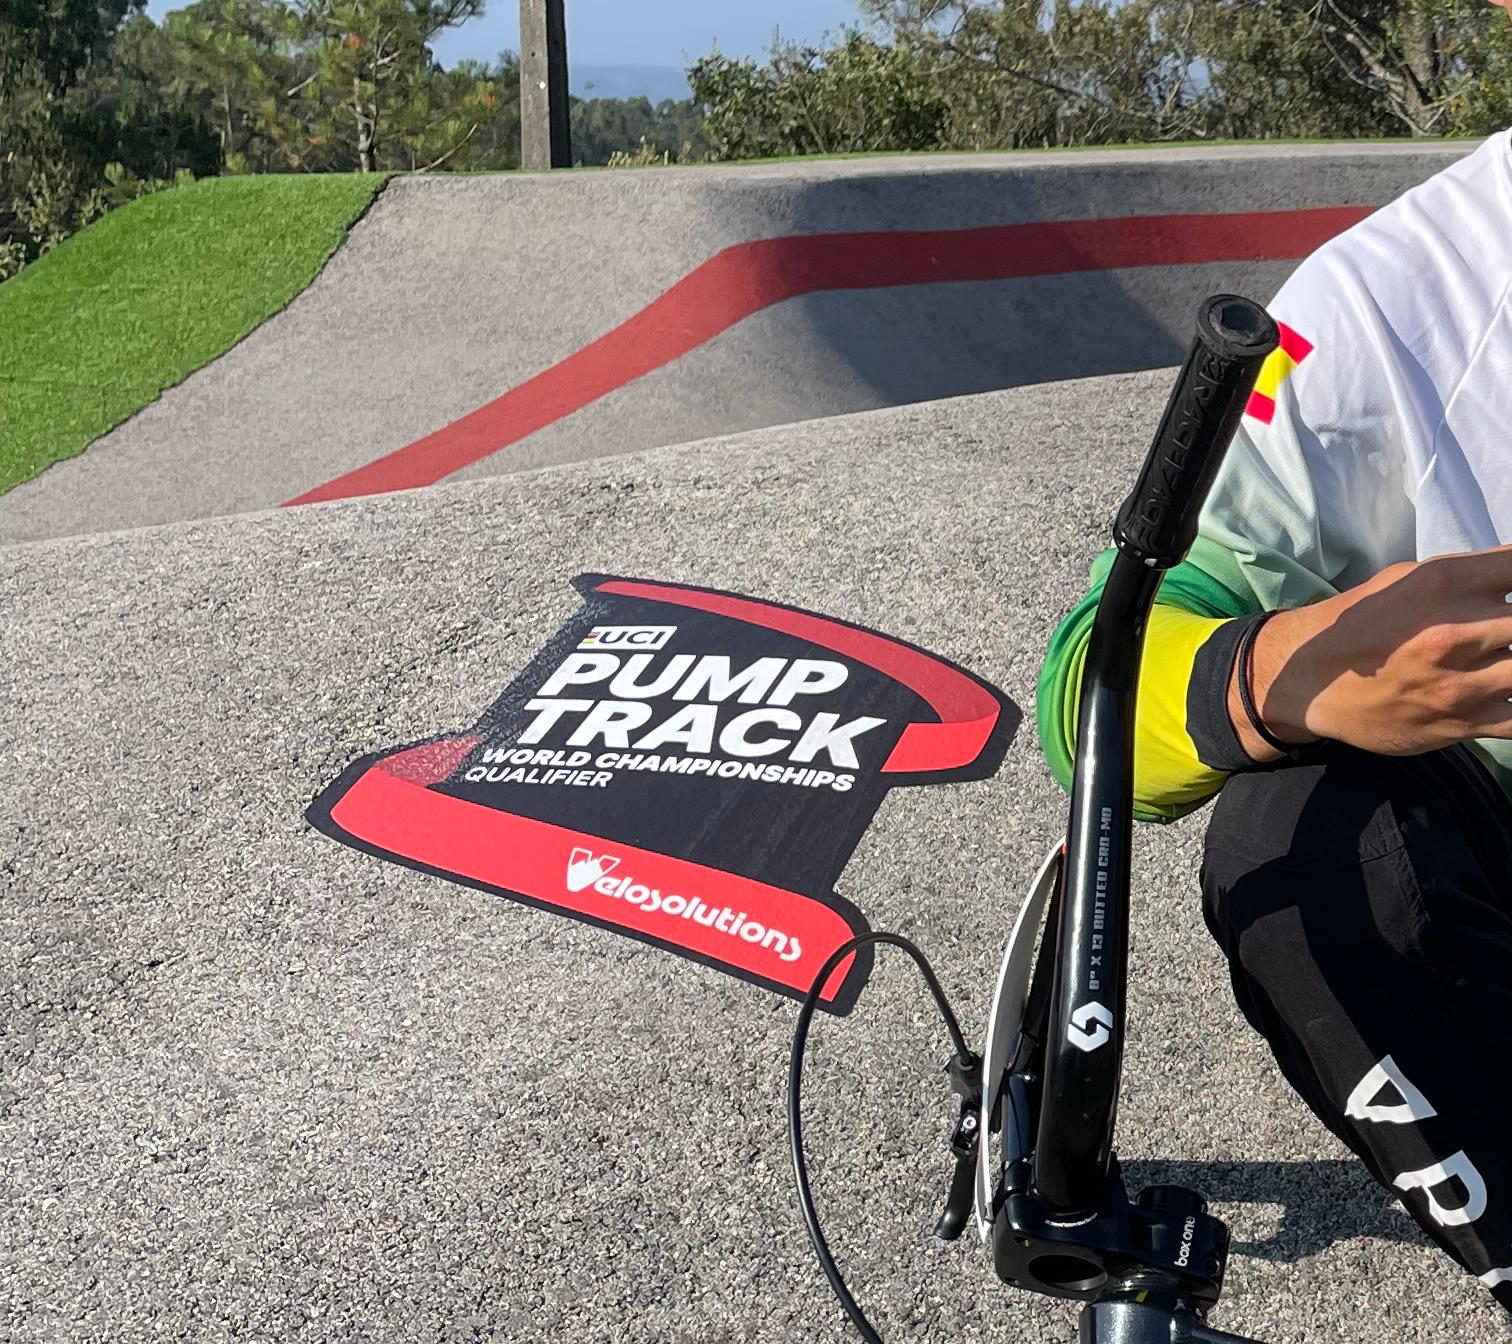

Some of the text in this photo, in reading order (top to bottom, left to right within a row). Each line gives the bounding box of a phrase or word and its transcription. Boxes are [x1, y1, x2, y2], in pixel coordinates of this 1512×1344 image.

[598, 630, 668, 645] UCI
[536, 652, 849, 706] PUMP
[517, 699, 887, 769] TRACK
[464, 767, 614, 788] QUALIFIER
[483, 749, 856, 792] WORLD CHAMPIONSHIPS
[566, 847, 802, 961] Velosolutions
[1173, 1214, 1196, 1267] box one
